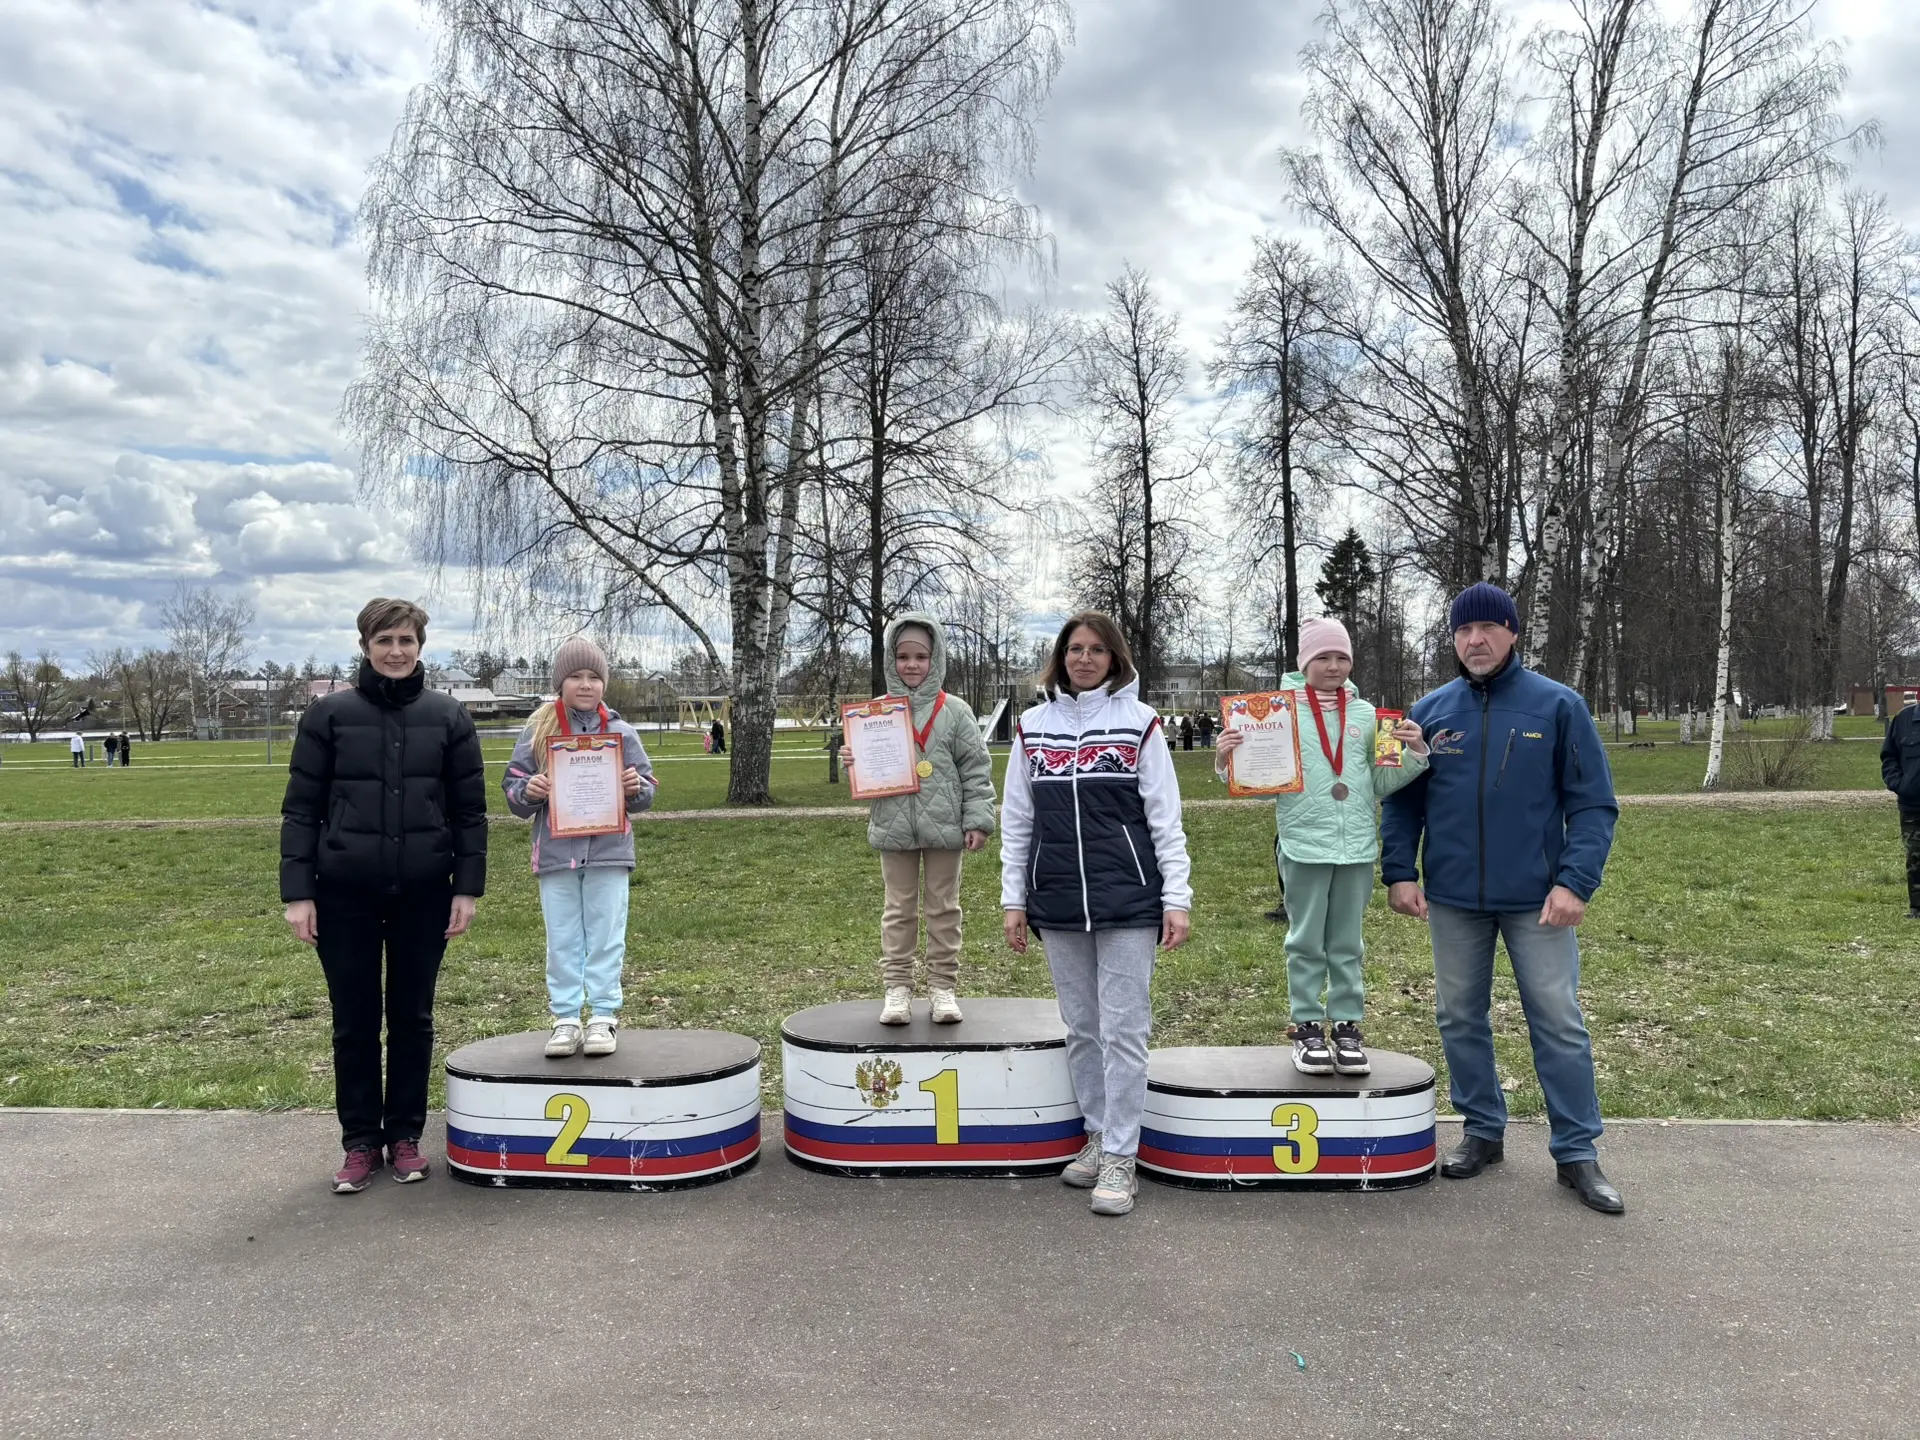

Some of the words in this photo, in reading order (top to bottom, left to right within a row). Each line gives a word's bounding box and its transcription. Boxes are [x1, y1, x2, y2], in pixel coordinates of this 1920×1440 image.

[863, 719, 894, 730] ДИПЛОМ
[1238, 721, 1284, 732] ГРАМОТА
[569, 755, 603, 765] ДИПЛОМ
[919, 1068, 959, 1145] 1
[544, 1093, 591, 1167] 2
[1270, 1103, 1320, 1175] 3
